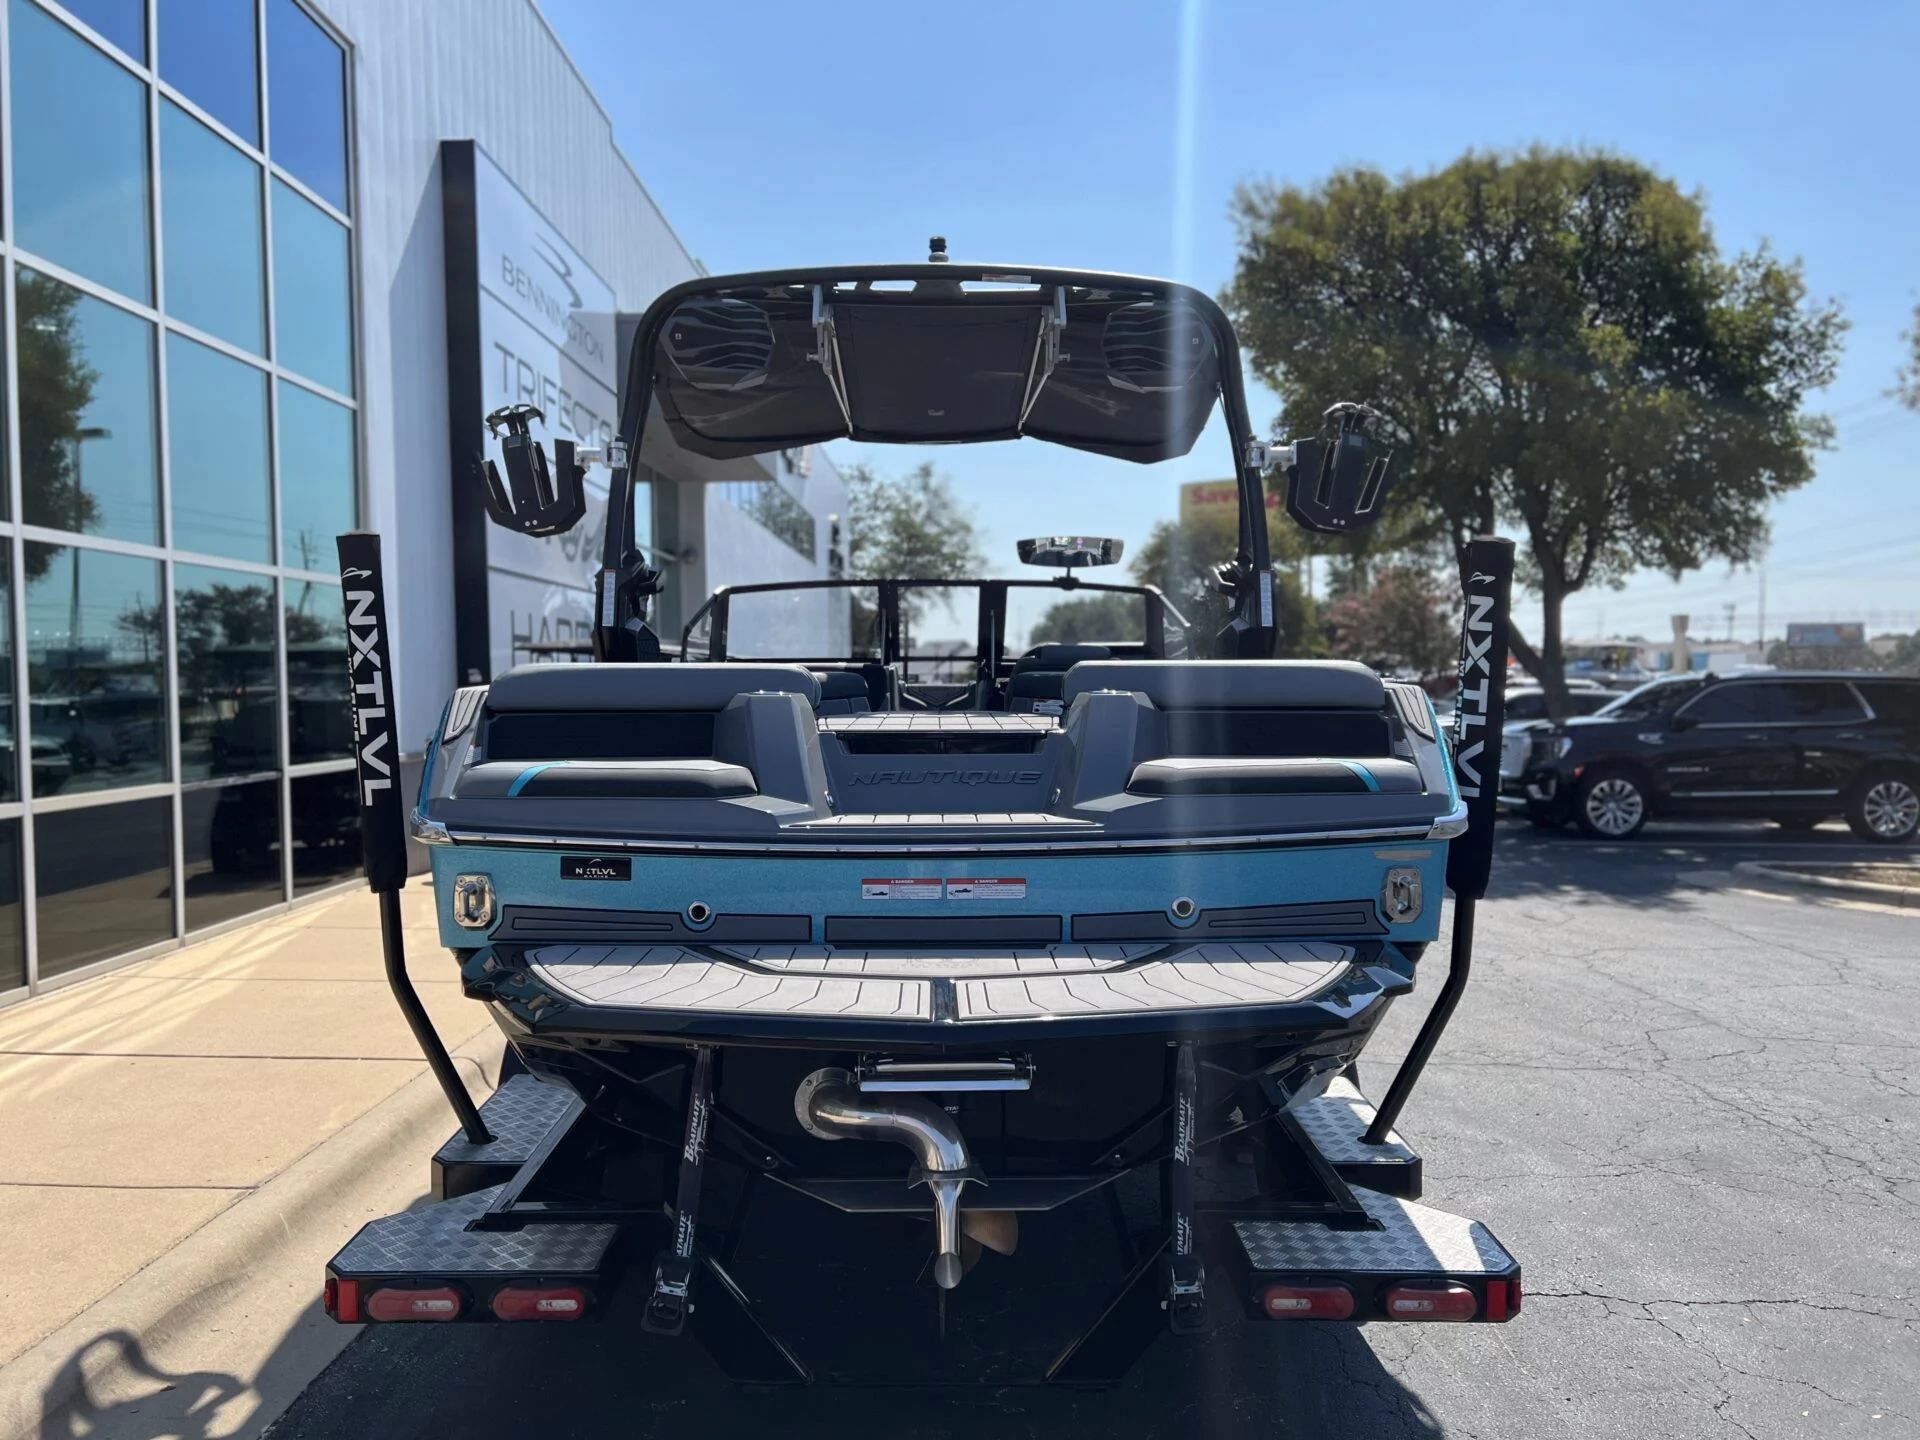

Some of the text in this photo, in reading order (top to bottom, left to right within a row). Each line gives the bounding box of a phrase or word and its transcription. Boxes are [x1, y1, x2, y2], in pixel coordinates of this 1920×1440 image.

[501, 252, 605, 364] BENNINGTON
[345, 589, 392, 807] NXTLVL
[847, 769, 1044, 787] NAUTIQUE
